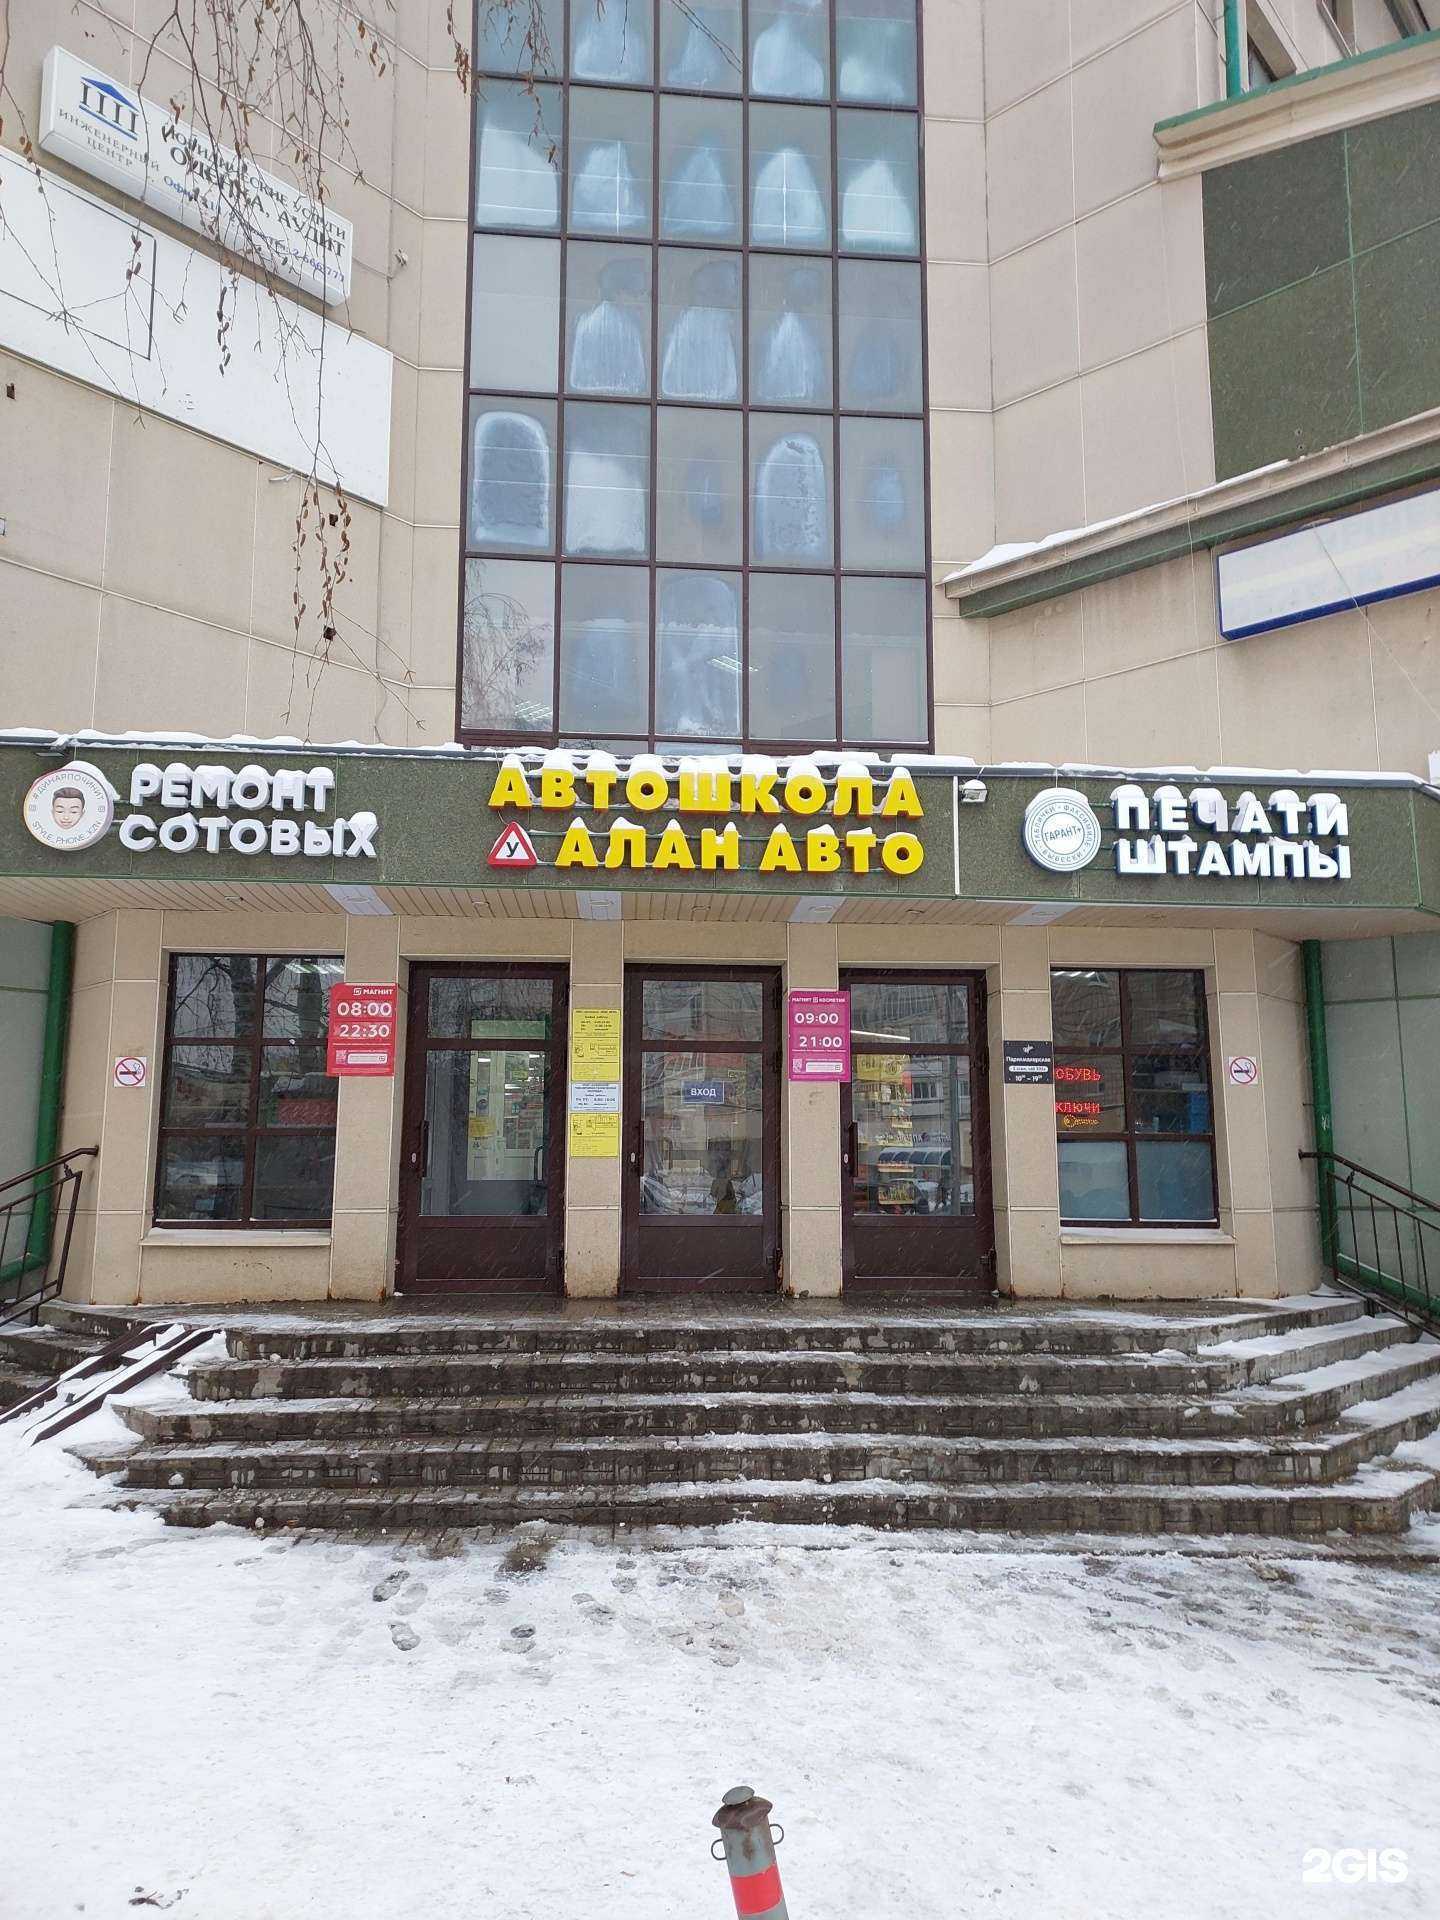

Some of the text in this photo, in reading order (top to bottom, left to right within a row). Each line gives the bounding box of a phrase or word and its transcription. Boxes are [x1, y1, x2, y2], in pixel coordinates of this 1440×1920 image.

[58, 108, 160, 171] ИНЖЕНЕРНЫЙ
[86, 136, 134, 169] ЦЕНТР
[278, 211, 346, 257] АУДИТ
[130, 765, 334, 812] РЕМОНТ
[488, 758, 925, 817] АВТОШКОЛА
[1112, 790, 1349, 836] ПЕЧАТИ
[118, 814, 378, 857] СОТОВЫХ
[1044, 825, 1082, 842] ГАРАНТ+
[505, 840, 519, 858] У
[555, 820, 926, 875] АЛАН АВТО
[1114, 837, 1352, 879] ШТАМПЫ
[337, 1002, 392, 1016] 08:00
[795, 1012, 839, 1024] 09:00
[339, 1024, 390, 1038] 22:30
[799, 1036, 842, 1048] 21:00
[1056, 1068, 1101, 1081] ОБУВЬ
[691, 1087, 717, 1097] ВХОД
[1055, 1102, 1100, 1113] КЛЮЧИ
